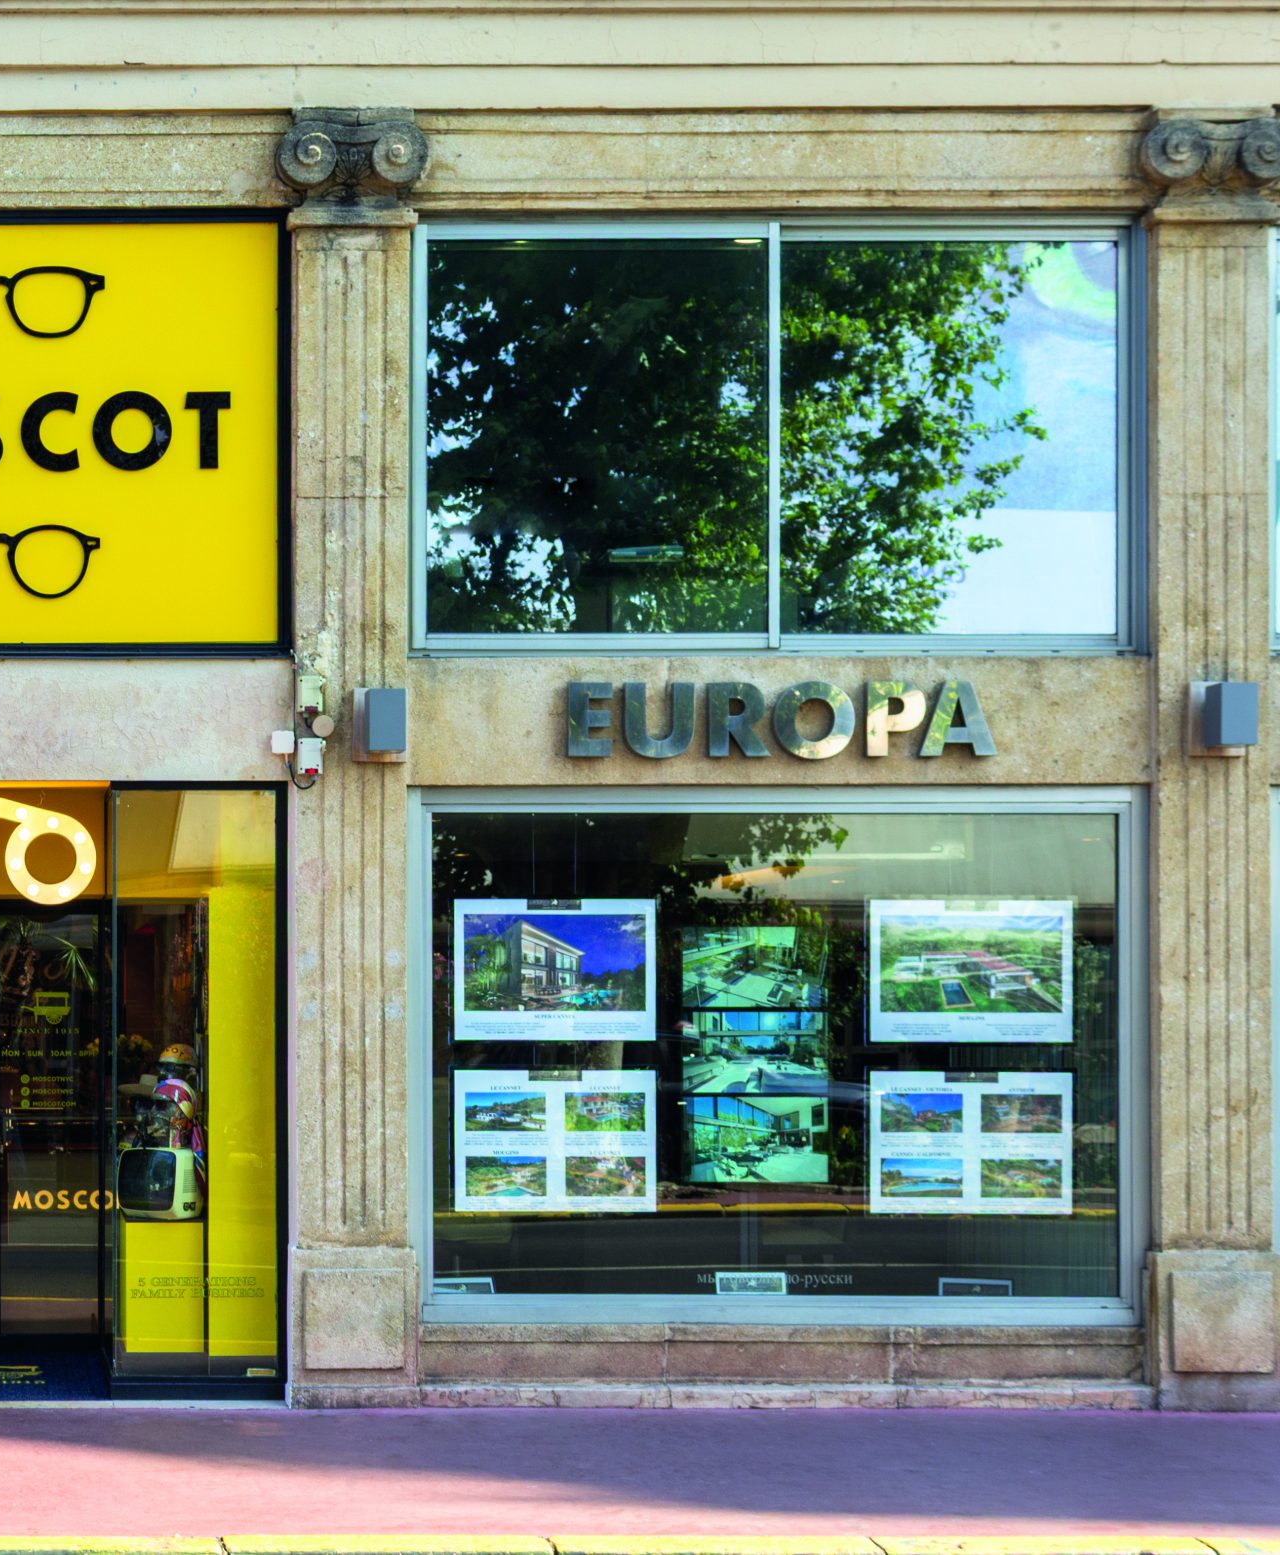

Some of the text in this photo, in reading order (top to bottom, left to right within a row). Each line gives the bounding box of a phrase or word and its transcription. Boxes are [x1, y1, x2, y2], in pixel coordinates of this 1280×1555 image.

[566, 679, 998, 758] EUROPA
[1, 1049, 20, 1057] MON
[27, 1049, 44, 1057] SUN
[51, 1049, 72, 1057] 10AM
[12, 1189, 119, 1210] MOSCO
[138, 1276, 257, 1287] 5 GENERATIONS
[131, 1288, 265, 1299] FAMILY BUSINESS
